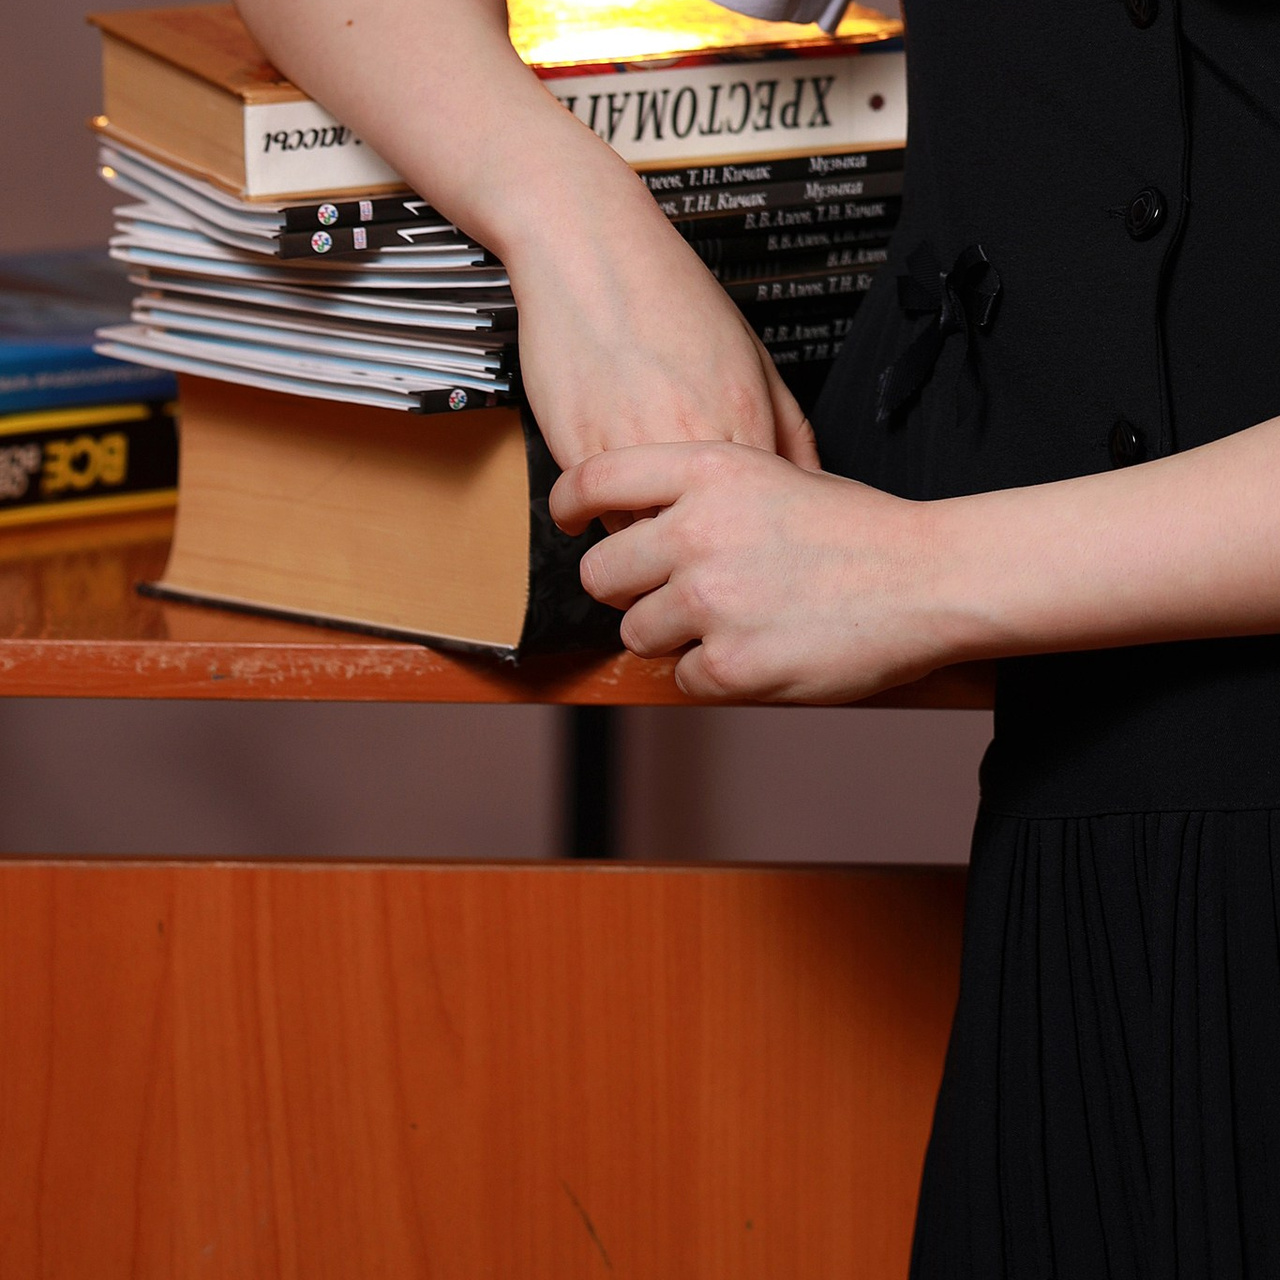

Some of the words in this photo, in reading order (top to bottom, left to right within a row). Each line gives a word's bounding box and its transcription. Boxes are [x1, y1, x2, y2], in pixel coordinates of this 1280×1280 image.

[556, 76, 835, 144] ХРЕСТОМАТ
[263, 124, 364, 153] лассы
[807, 154, 869, 176] Музыка
[804, 180, 864, 203] Музыка
